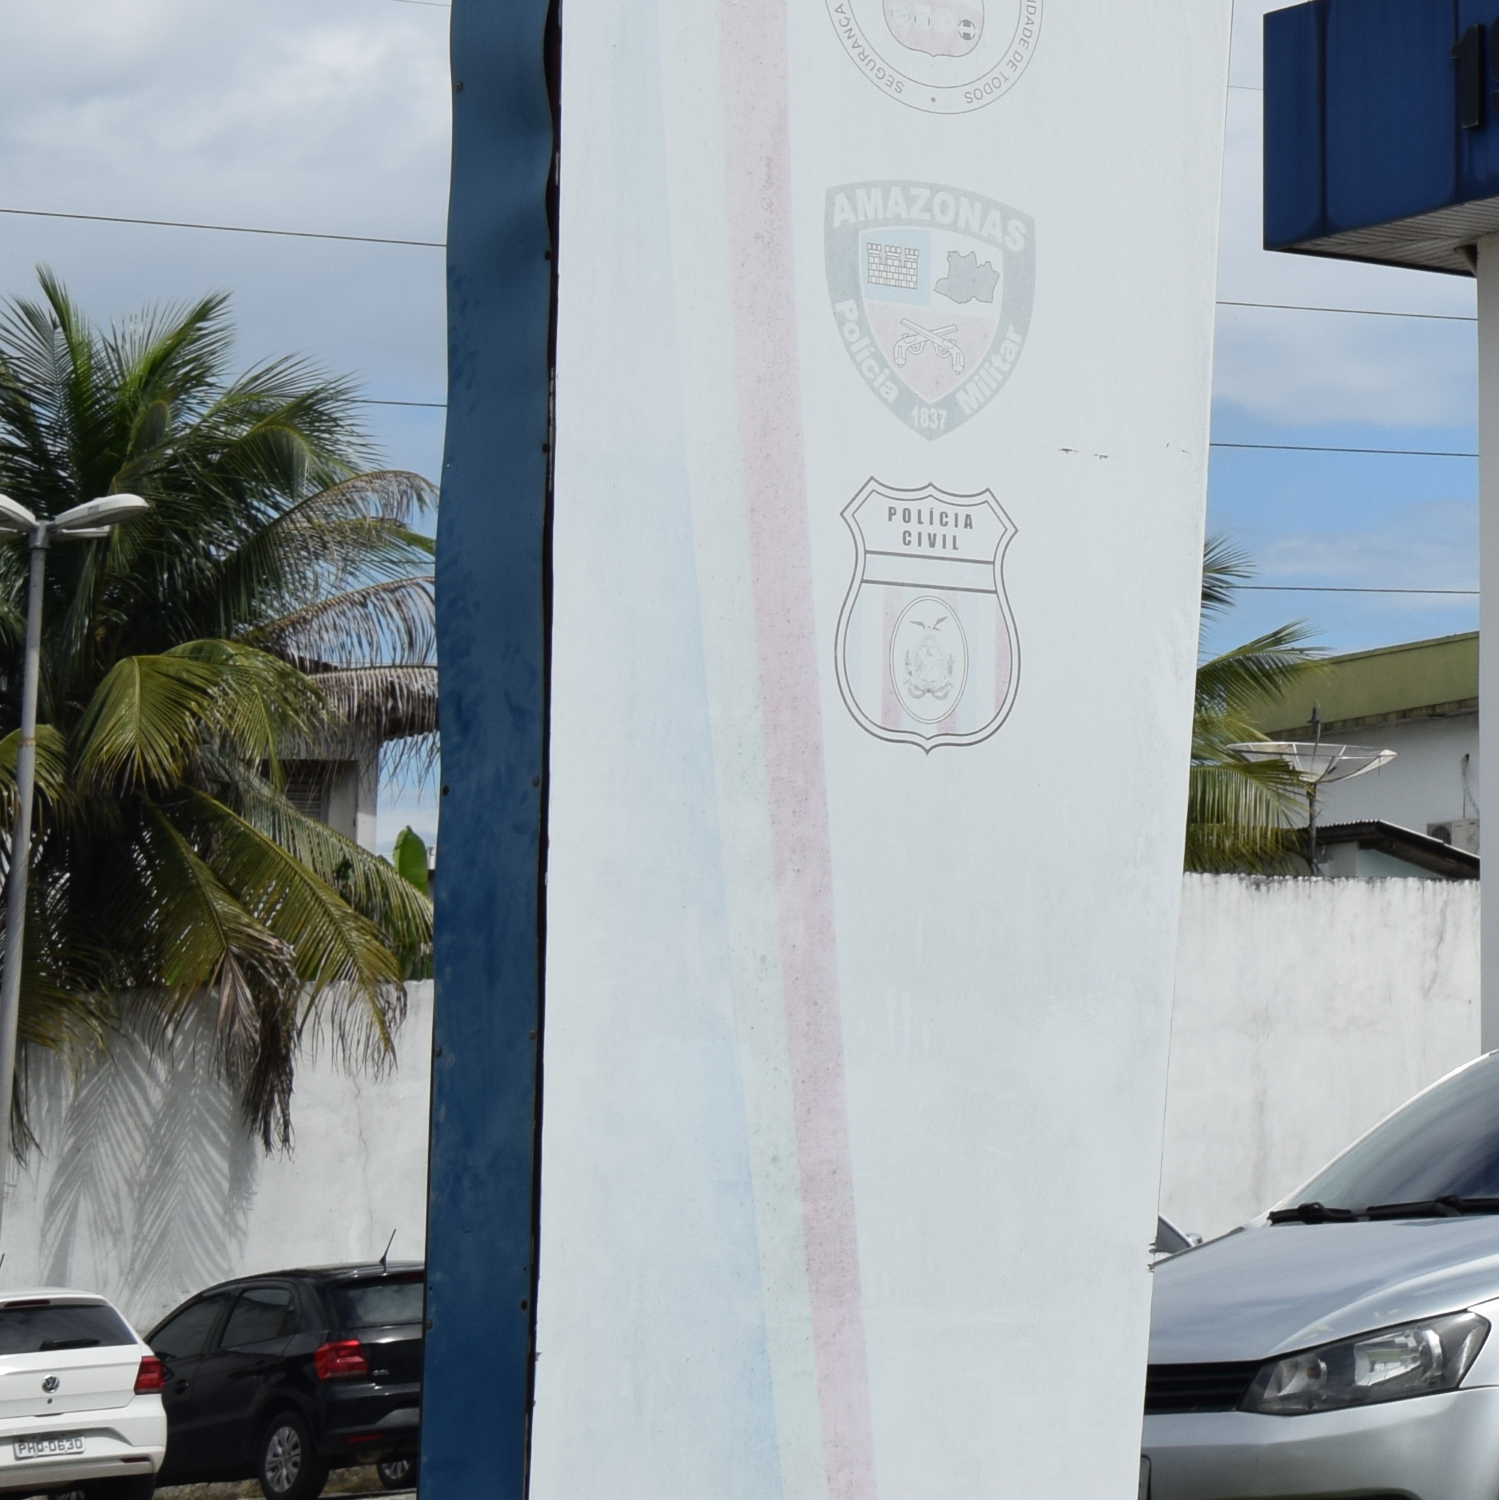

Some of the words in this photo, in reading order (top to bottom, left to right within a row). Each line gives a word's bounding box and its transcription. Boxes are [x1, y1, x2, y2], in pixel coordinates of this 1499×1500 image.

[834, 3, 905, 94] SEGURANÇA
[1006, 51, 1024, 73] DE
[964, 71, 1010, 104] TODOS
[833, 186, 1027, 253] AMAZONAS
[955, 325, 1023, 415] Militar
[911, 406, 948, 430] 1837
[888, 506, 974, 530] POLÍCIA
[902, 530, 959, 551] CIVIL
